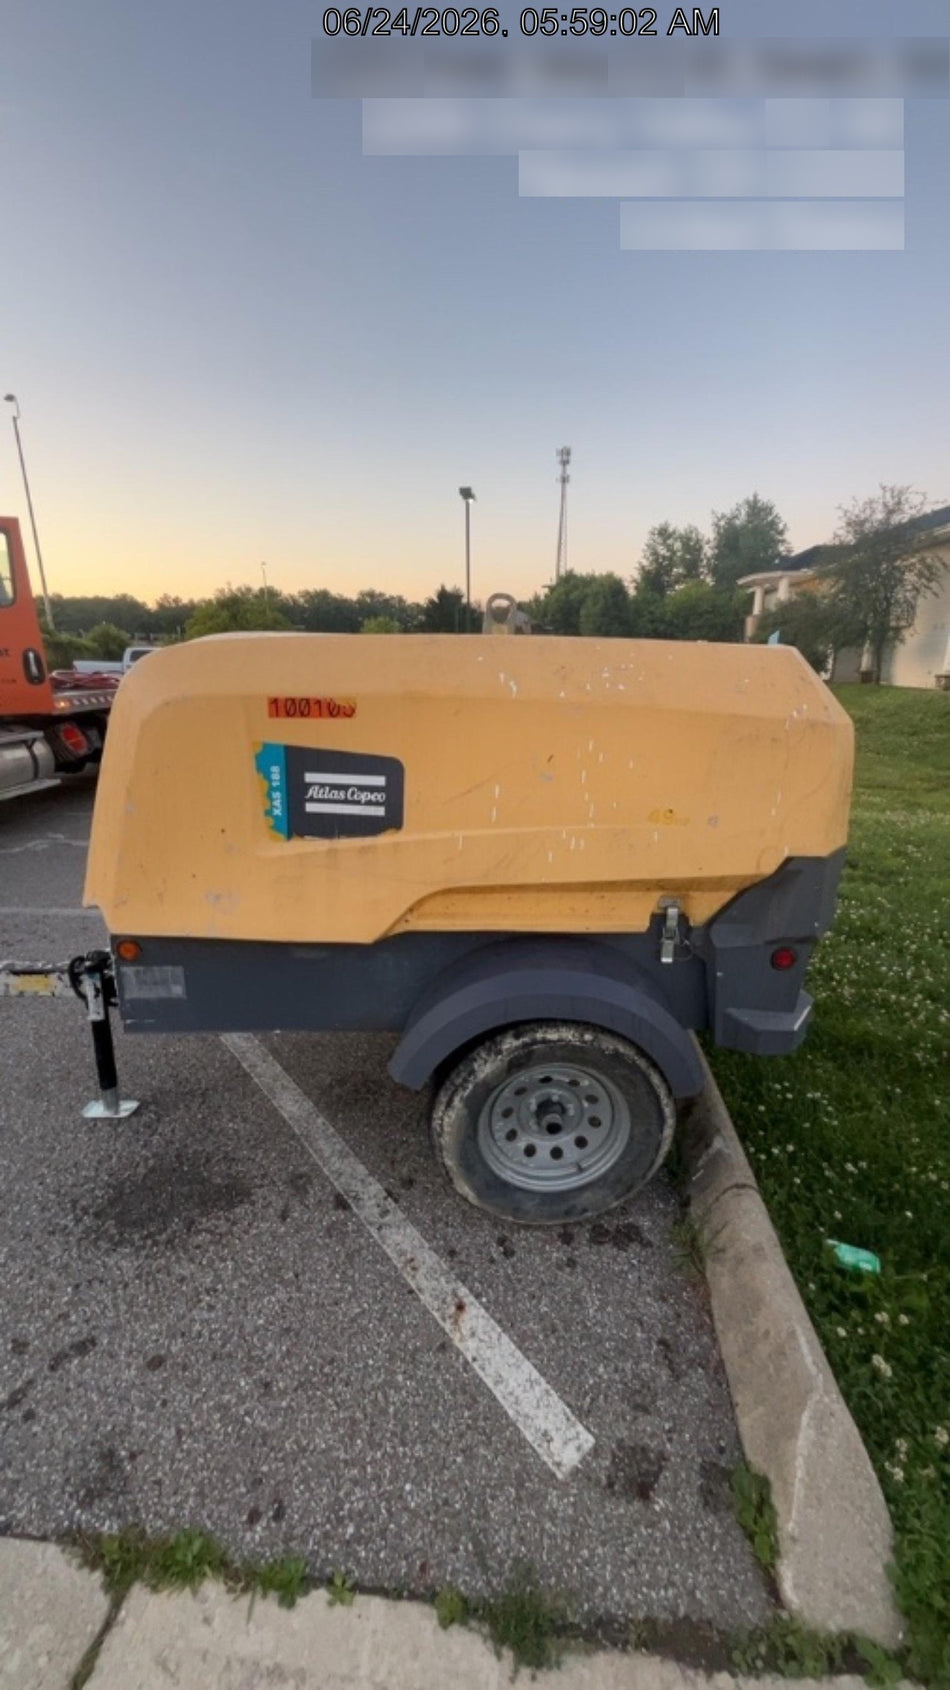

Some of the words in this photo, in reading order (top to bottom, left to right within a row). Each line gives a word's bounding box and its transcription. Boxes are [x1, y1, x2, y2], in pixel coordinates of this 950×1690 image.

[270, 765, 281, 787] 188
[271, 791, 282, 816] XAS
[305, 785, 346, 801] Atlas
[347, 786, 386, 804] Copco
